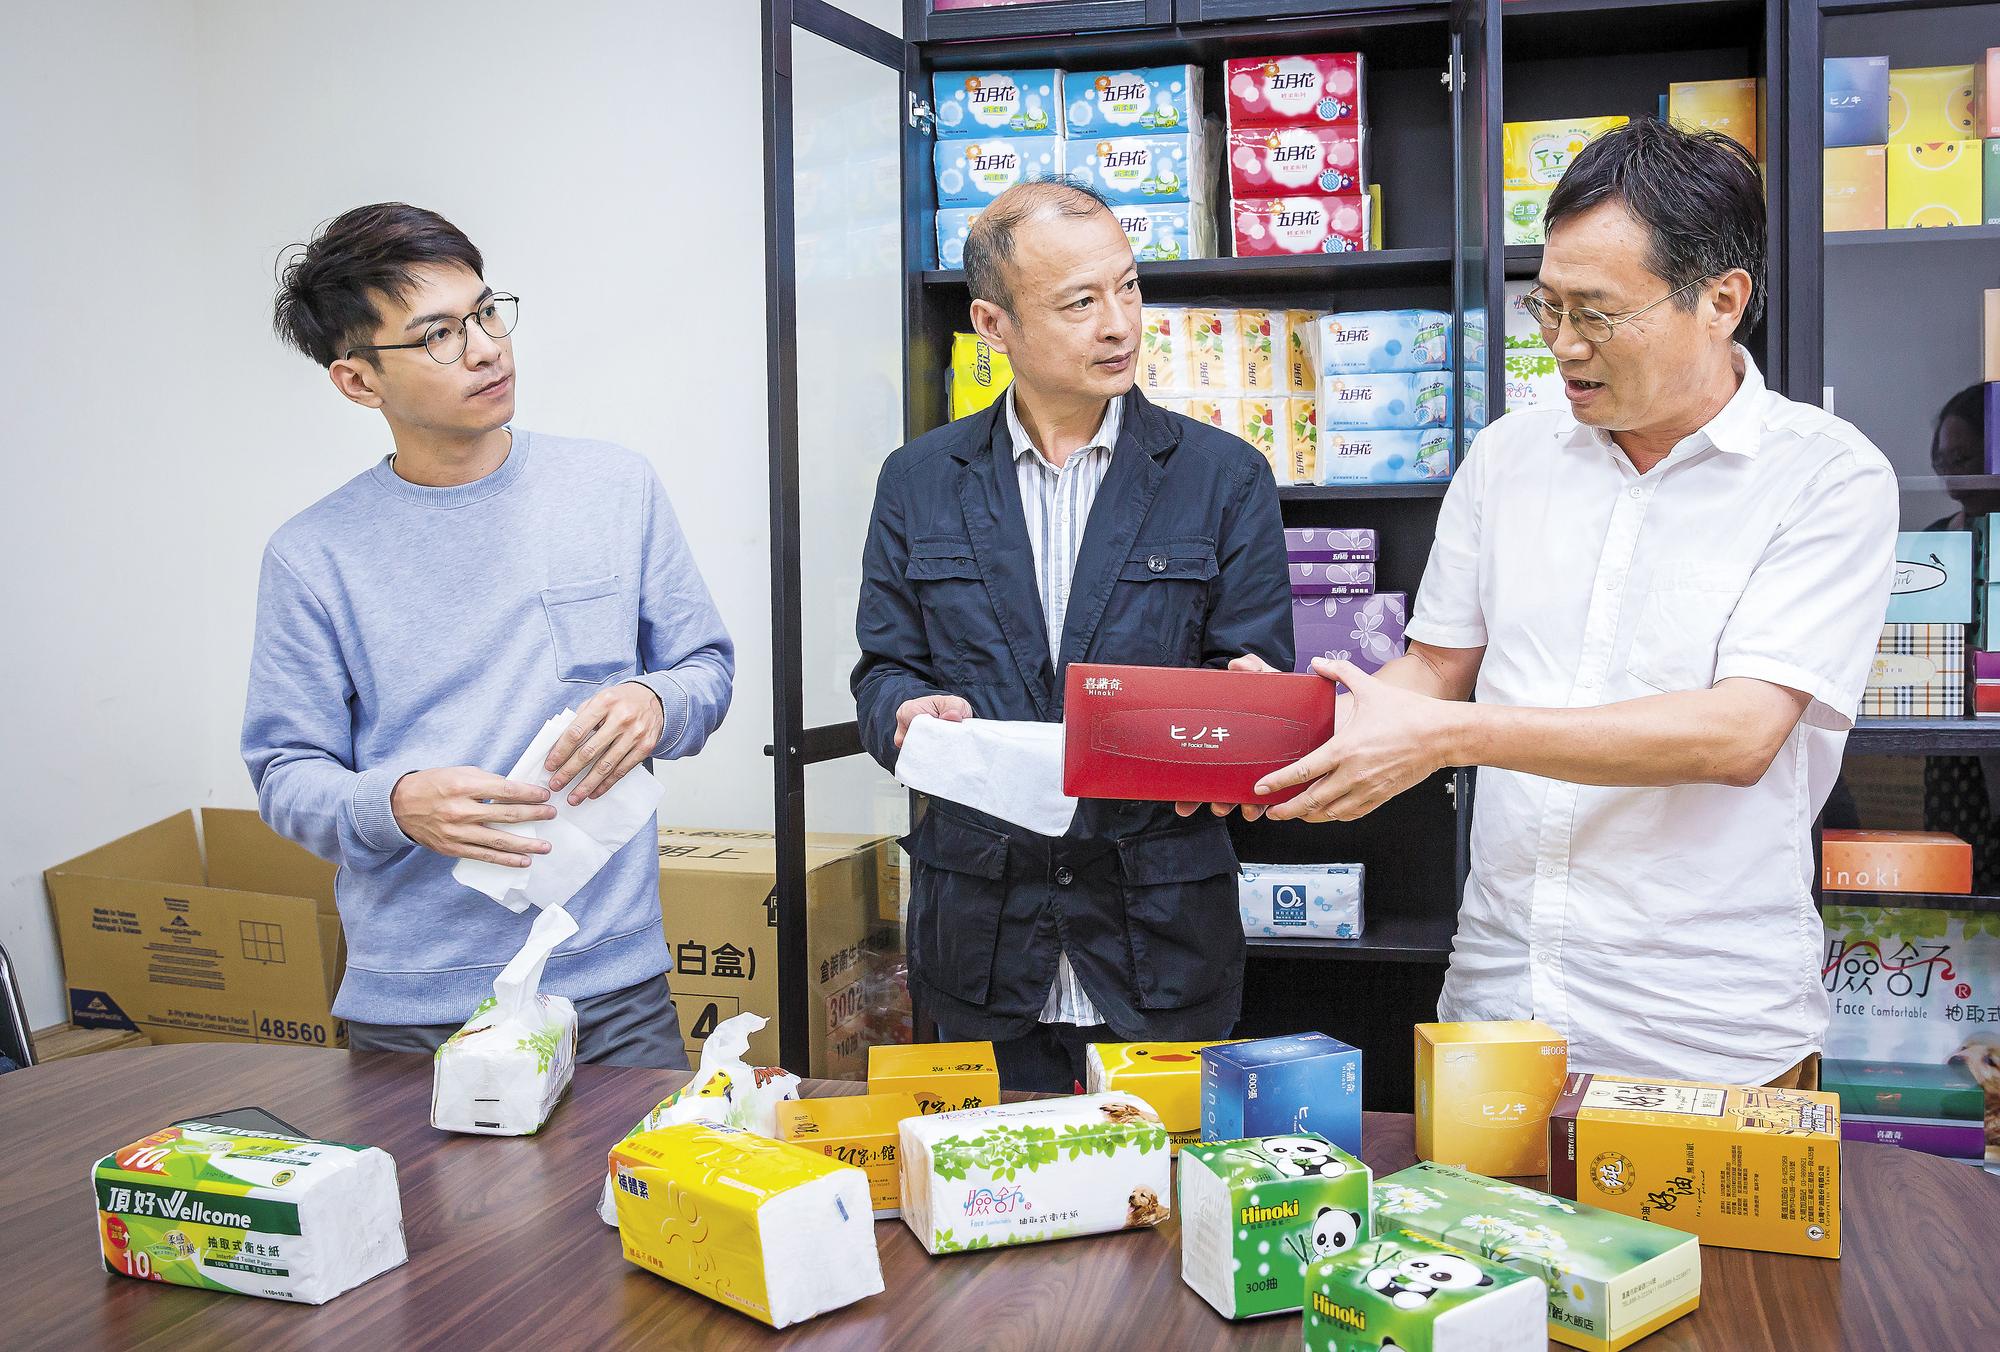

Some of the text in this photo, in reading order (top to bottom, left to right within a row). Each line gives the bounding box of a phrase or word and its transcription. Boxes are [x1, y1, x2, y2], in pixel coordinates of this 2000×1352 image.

[1271, 72, 1316, 90] 五月花
[972, 86, 1016, 103] 五月花
[1102, 84, 1147, 102] 五月花
[1830, 96, 1862, 105] ヒノキ
[974, 154, 1017, 171] 五月花
[1104, 150, 1148, 168] 五月花
[1273, 145, 1317, 162] 五月花
[1277, 210, 1321, 228] 五月花
[1336, 329, 1372, 343] 五月花
[1338, 388, 1375, 401] 五月花
[1338, 443, 1375, 456] 五月花
[1170, 724, 1231, 742] ヒノキ
[1826, 867, 1899, 886] inoki
[1836, 998, 1928, 1019] Face Comfortable
[260, 1018, 326, 1044] 48560
[1482, 1103, 1528, 1116] ヒノキ
[107, 1186, 252, 1228] 頂好 Wellcome
[1241, 1198, 1300, 1226] Hinoki
[208, 1236, 280, 1258] 抽取式衛生紙
[123, 1249, 150, 1278] 10
[1246, 1278, 1278, 1294] 300抽
[1312, 1290, 1366, 1332] Hinoki
